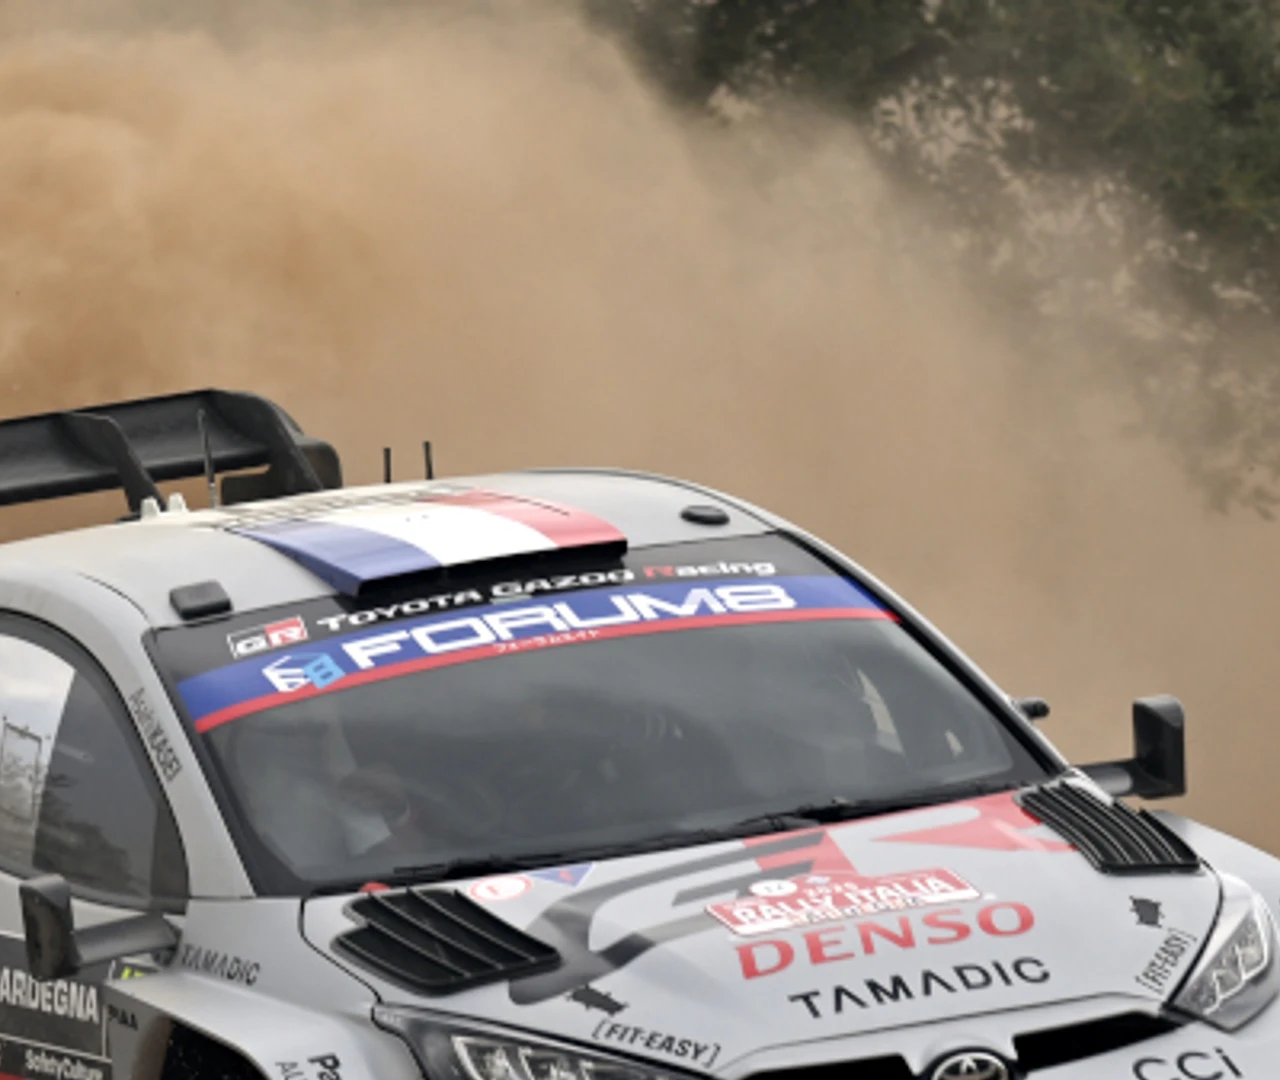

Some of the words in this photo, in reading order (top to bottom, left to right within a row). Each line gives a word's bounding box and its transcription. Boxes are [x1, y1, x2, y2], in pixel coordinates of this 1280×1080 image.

[317, 587, 484, 632] TOYOTA
[491, 567, 635, 600] GAZOO
[643, 560, 777, 580] Racing
[341, 584, 798, 670] FORUM8
[232, 616, 309, 658] GR
[733, 895, 836, 927] RALLY
[844, 876, 956, 907] ITALIA
[180, 943, 261, 987] TAMADIC
[734, 902, 1036, 981] DENSO
[787, 956, 1051, 1019] TAMADIC
